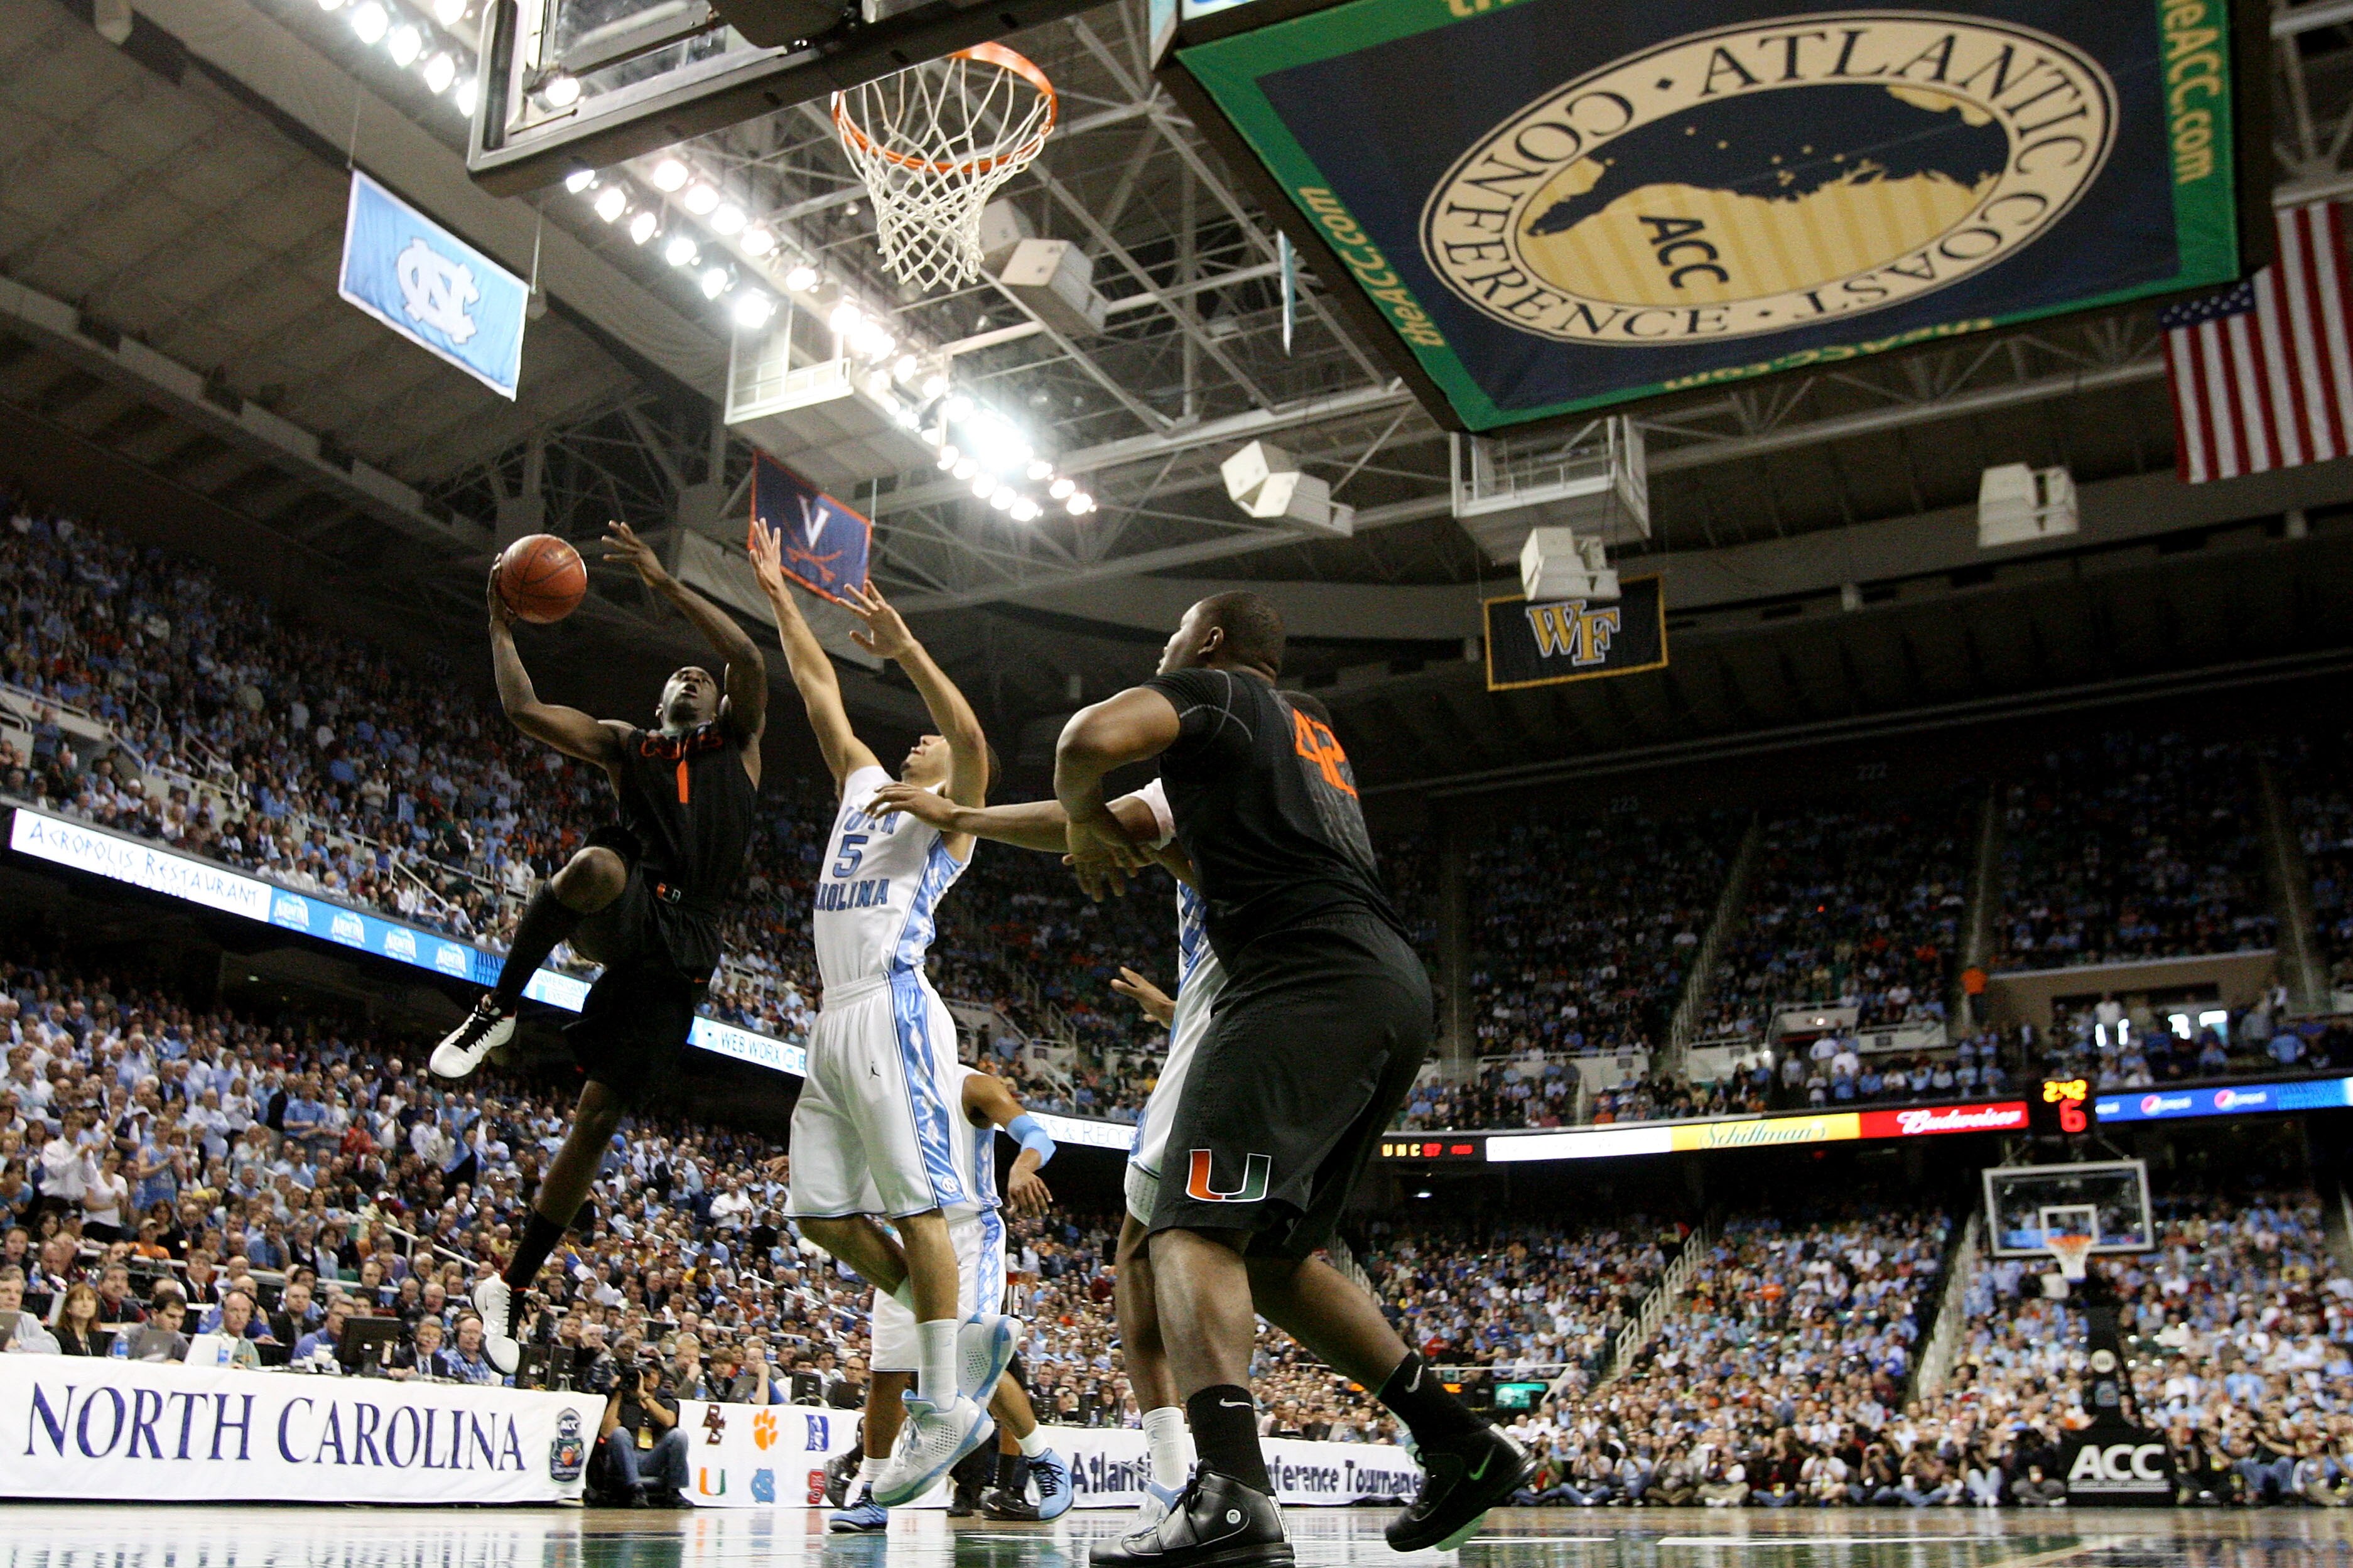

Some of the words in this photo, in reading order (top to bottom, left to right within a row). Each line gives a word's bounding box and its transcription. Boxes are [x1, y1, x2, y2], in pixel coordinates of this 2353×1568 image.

[1699, 30, 2089, 183] ATLANTIC
[2163, 0, 2221, 183] eACC.com
[1442, 90, 1731, 335] CONFERENCE
[1299, 187, 1446, 347] theACC.com
[1638, 214, 1729, 289] ACC
[1793, 192, 2050, 318] COAST
[796, 492, 831, 549] V
[1525, 598, 1621, 667] WF
[676, 760, 690, 804] 1
[29, 819, 133, 869] ACROPOLIS
[145, 852, 259, 908] RESTAURANT
[833, 835, 868, 878] 5
[720, 1031, 745, 1054] WEB
[1896, 1108, 2021, 1134] Budweiser
[2059, 1099, 2087, 1132] 6
[1186, 1149, 1272, 1203] U
[1382, 1144, 1420, 1157] UNC
[24, 1382, 256, 1461] NORTH
[277, 1397, 527, 1472] CAROLINA
[1071, 1451, 1153, 1494] Atlanti
[1267, 1455, 1339, 1492] ference
[1345, 1459, 1421, 1494] Tourname
[2067, 1444, 2166, 1481] ACC
